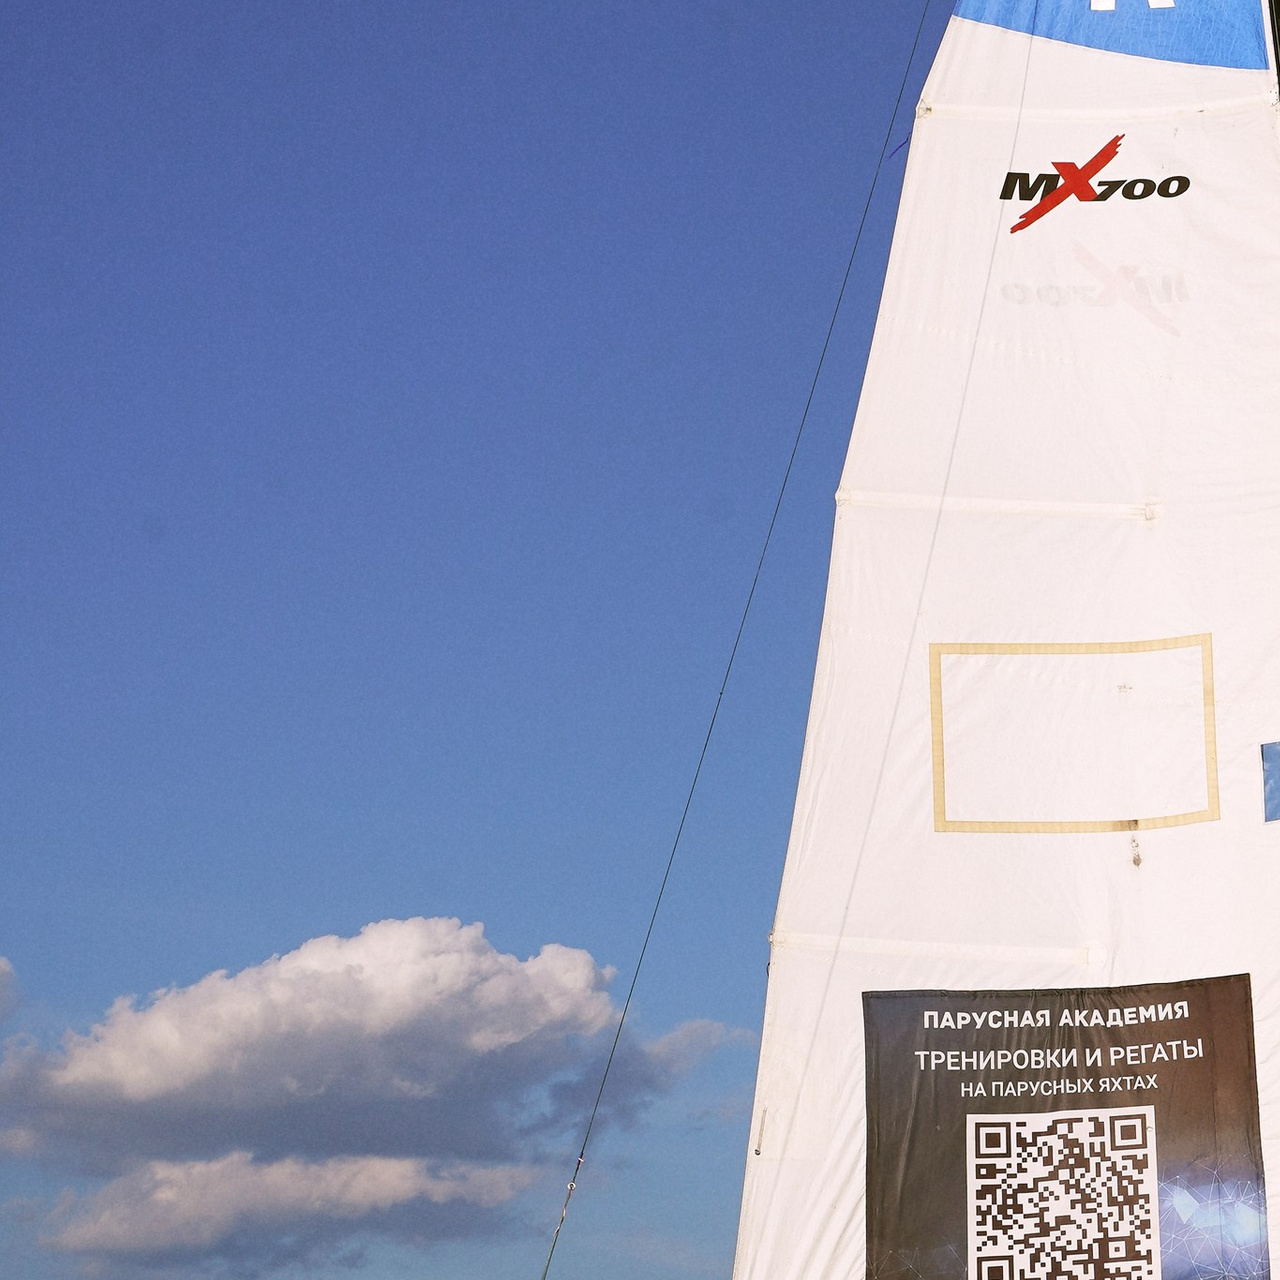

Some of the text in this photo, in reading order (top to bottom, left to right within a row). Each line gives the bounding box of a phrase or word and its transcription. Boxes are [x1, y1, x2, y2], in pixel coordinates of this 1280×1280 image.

[999, 133, 1191, 234] MX700
[923, 1000, 1189, 1030] ПАРУСНАЯ АКАДЕМИЯ
[914, 1038, 1204, 1071] ТРЕНИРОВКИ И РЕГАТЫ
[960, 1073, 1159, 1098] НА ПАРУСНЫХ ЯХТАХ
